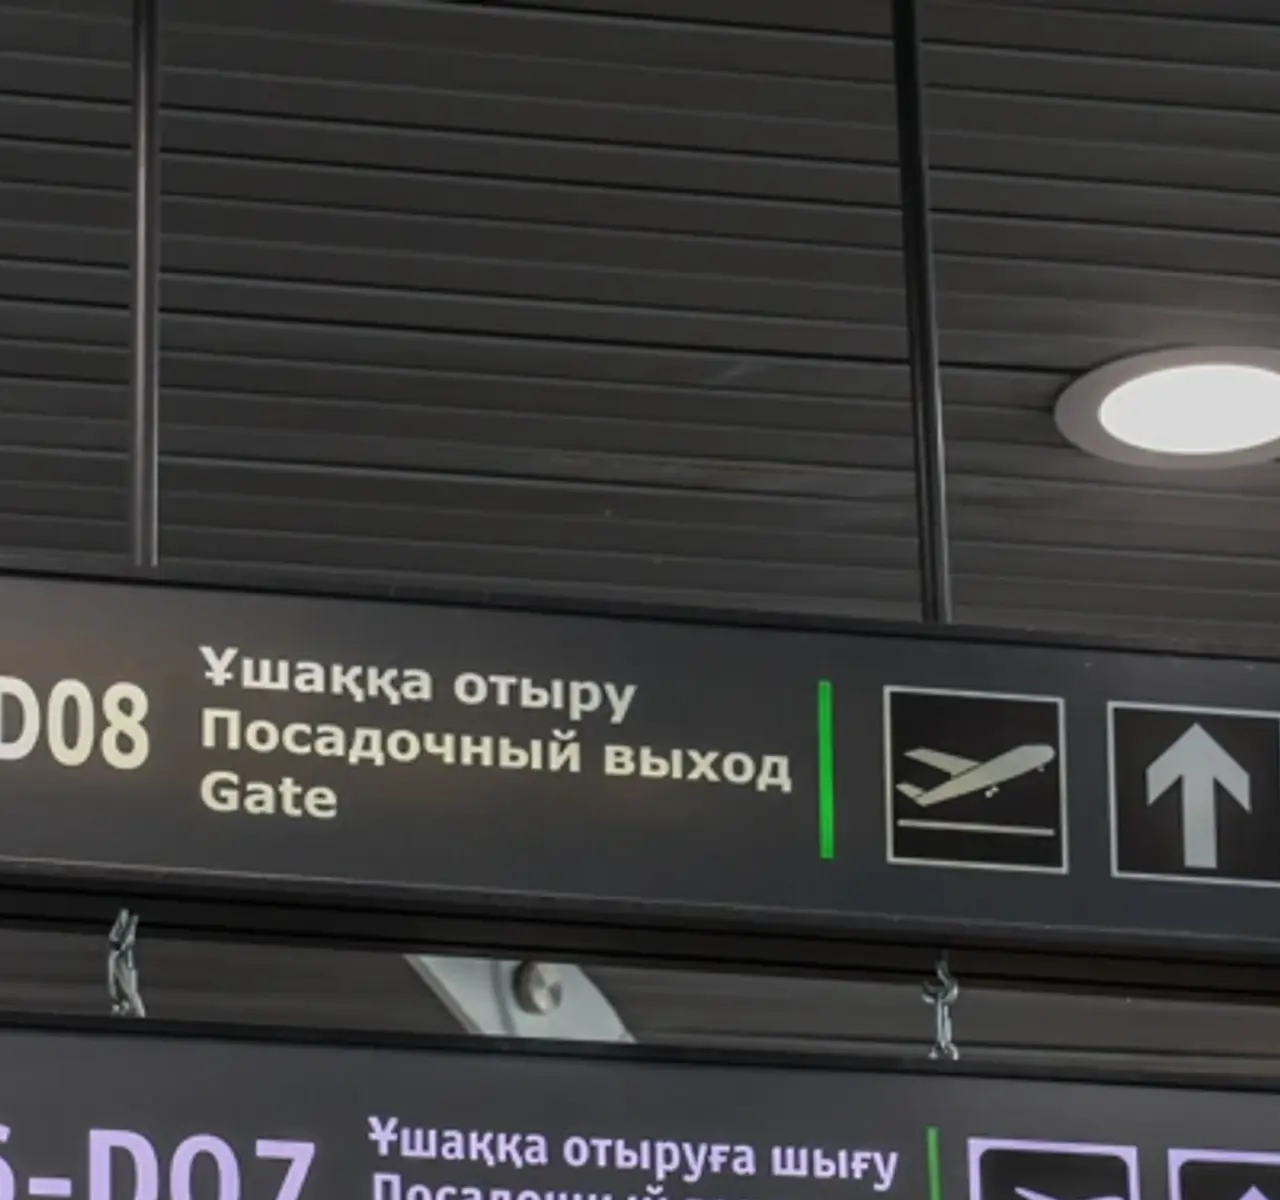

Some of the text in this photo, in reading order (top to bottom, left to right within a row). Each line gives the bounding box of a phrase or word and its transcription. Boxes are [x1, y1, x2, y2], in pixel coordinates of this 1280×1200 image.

[197, 643, 638, 725] Ұшаққа отыру
[200, 706, 793, 794] Посадочный выход
[198, 769, 339, 820] Gate
[366, 1114, 900, 1193] Ұшаққа отыруға шығу
